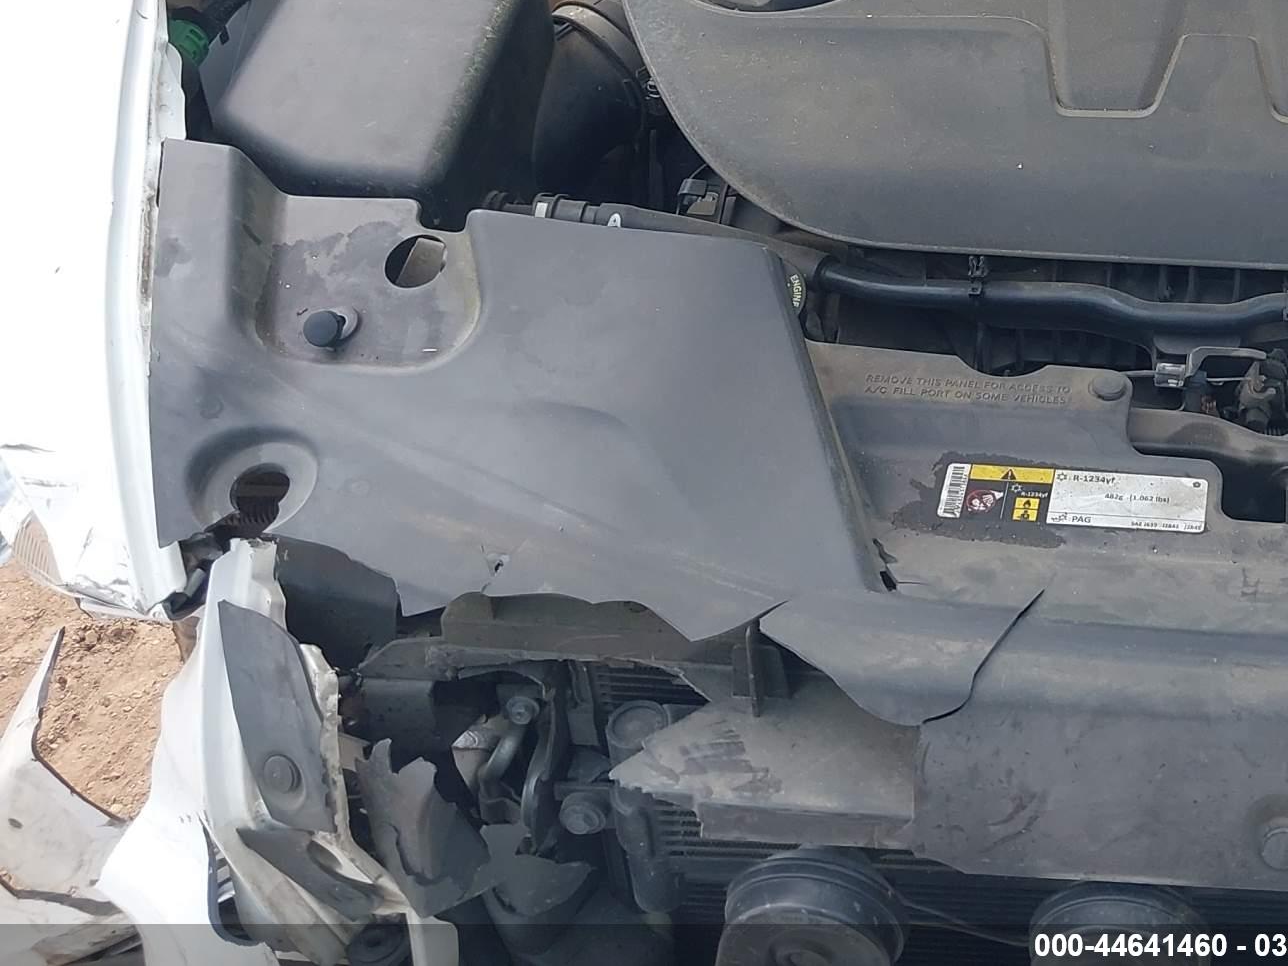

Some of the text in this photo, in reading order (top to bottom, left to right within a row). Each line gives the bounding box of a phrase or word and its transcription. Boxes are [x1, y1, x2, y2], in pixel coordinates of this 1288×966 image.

[790, 274, 802, 308] ENGINE
[865, 374, 913, 385] REMOVE
[917, 377, 942, 387] THIS
[945, 378, 980, 389] PANEL
[984, 381, 1006, 390] FOR
[1057, 385, 1071, 394] TO
[864, 385, 1066, 404] A/C FILL PORT ON SOME VEHICLES
[1073, 475, 1115, 485] R-1234yf
[1071, 515, 1092, 524] PAG
